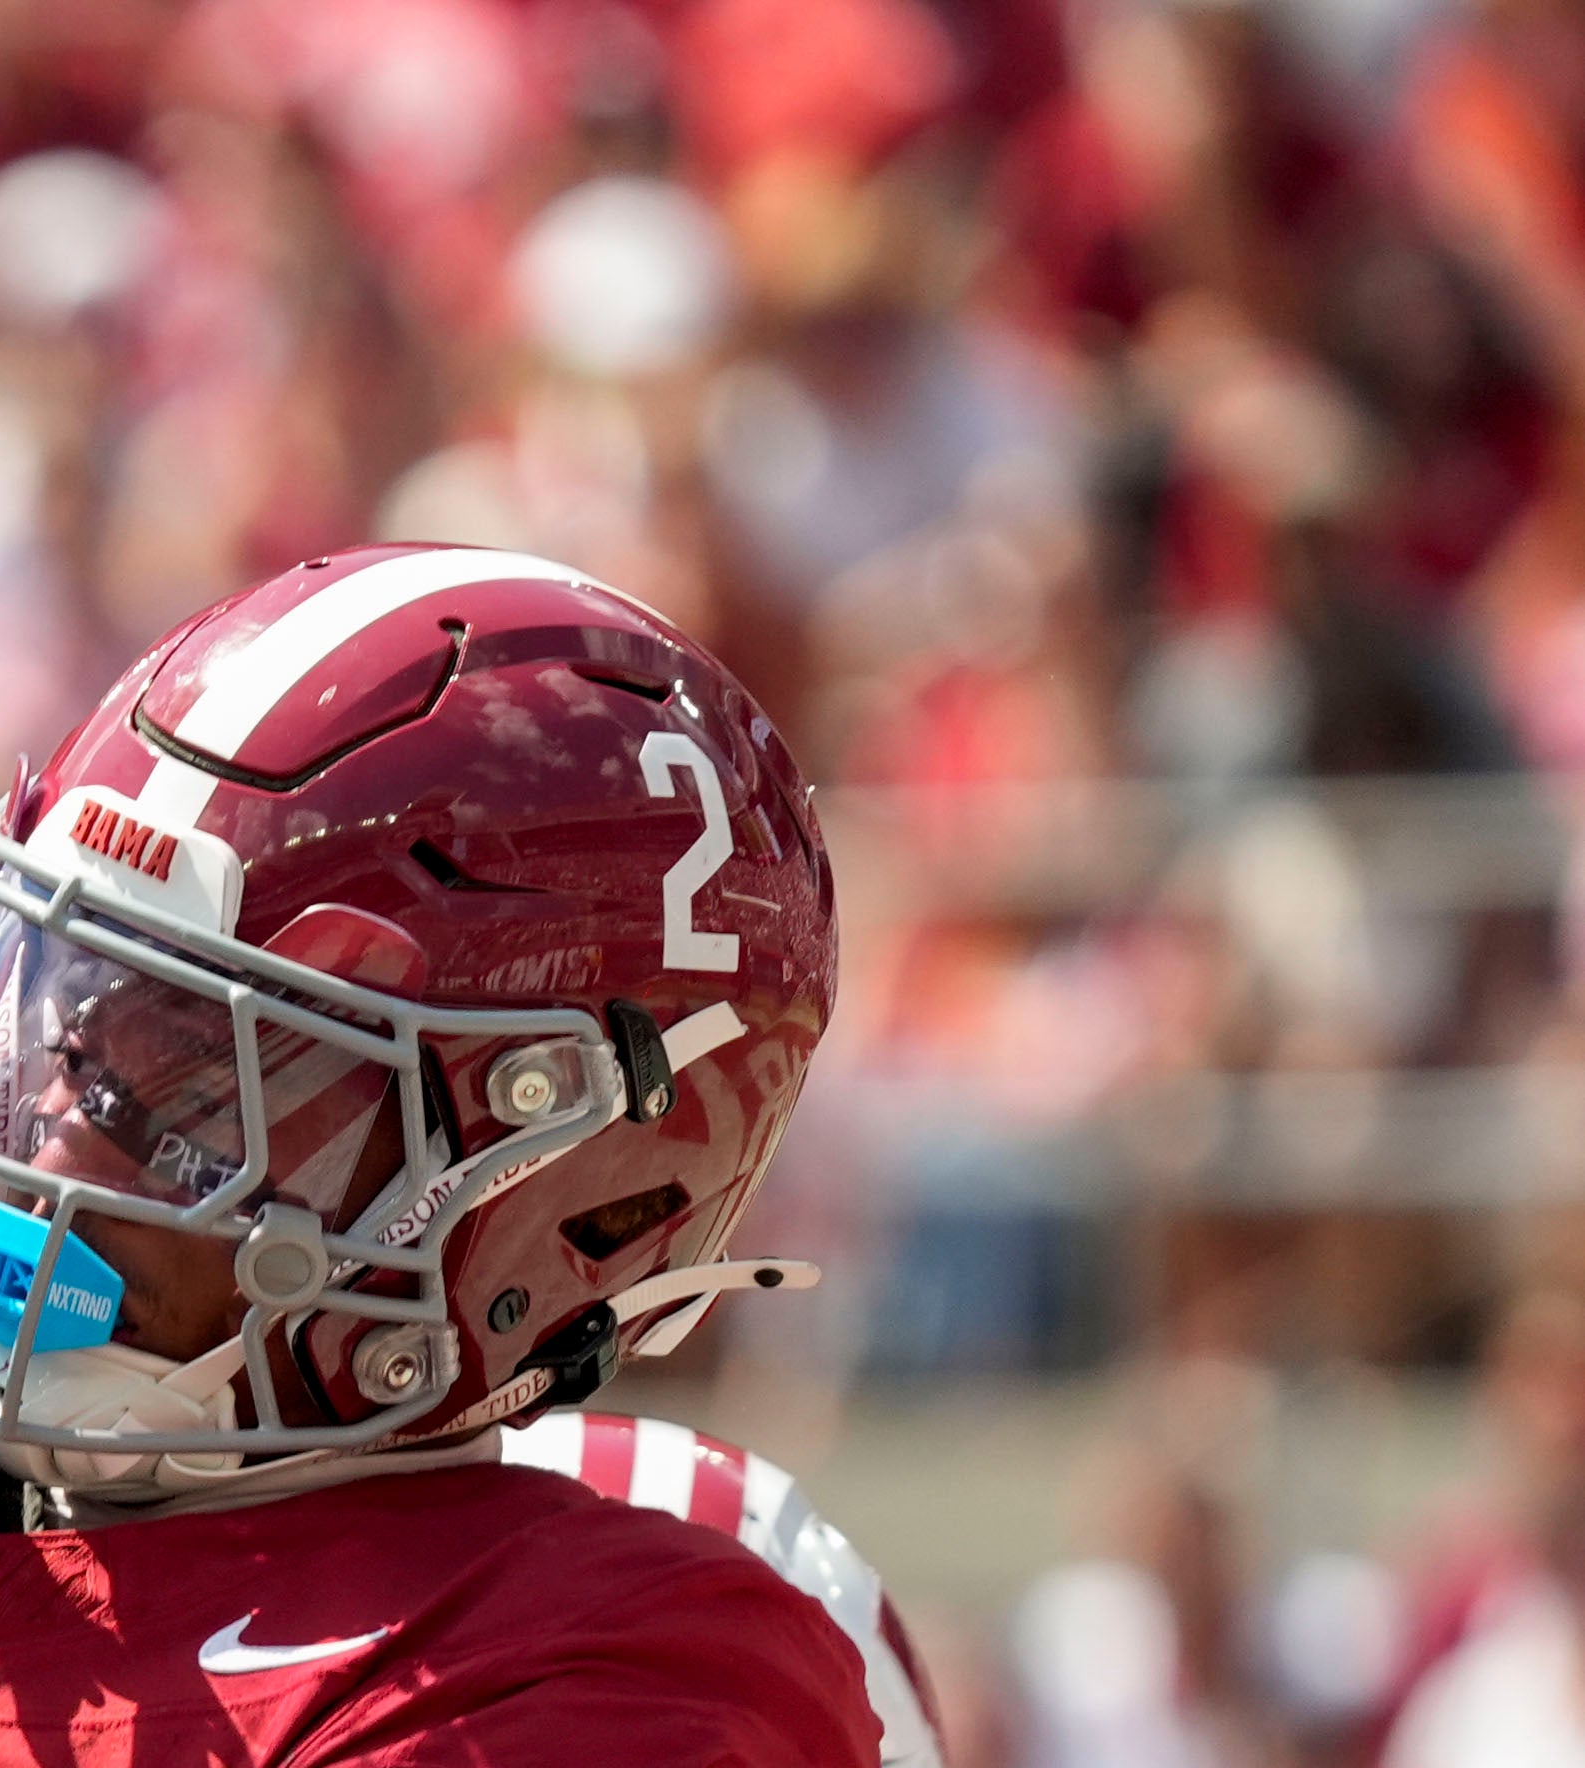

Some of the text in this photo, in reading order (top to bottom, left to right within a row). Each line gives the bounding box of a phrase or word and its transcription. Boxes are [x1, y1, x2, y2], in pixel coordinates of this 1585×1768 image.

[69, 799, 178, 883] BAMA
[638, 731, 740, 972] 2
[47, 1282, 113, 1323] NXTRND
[483, 1369, 548, 1419] TIDE
